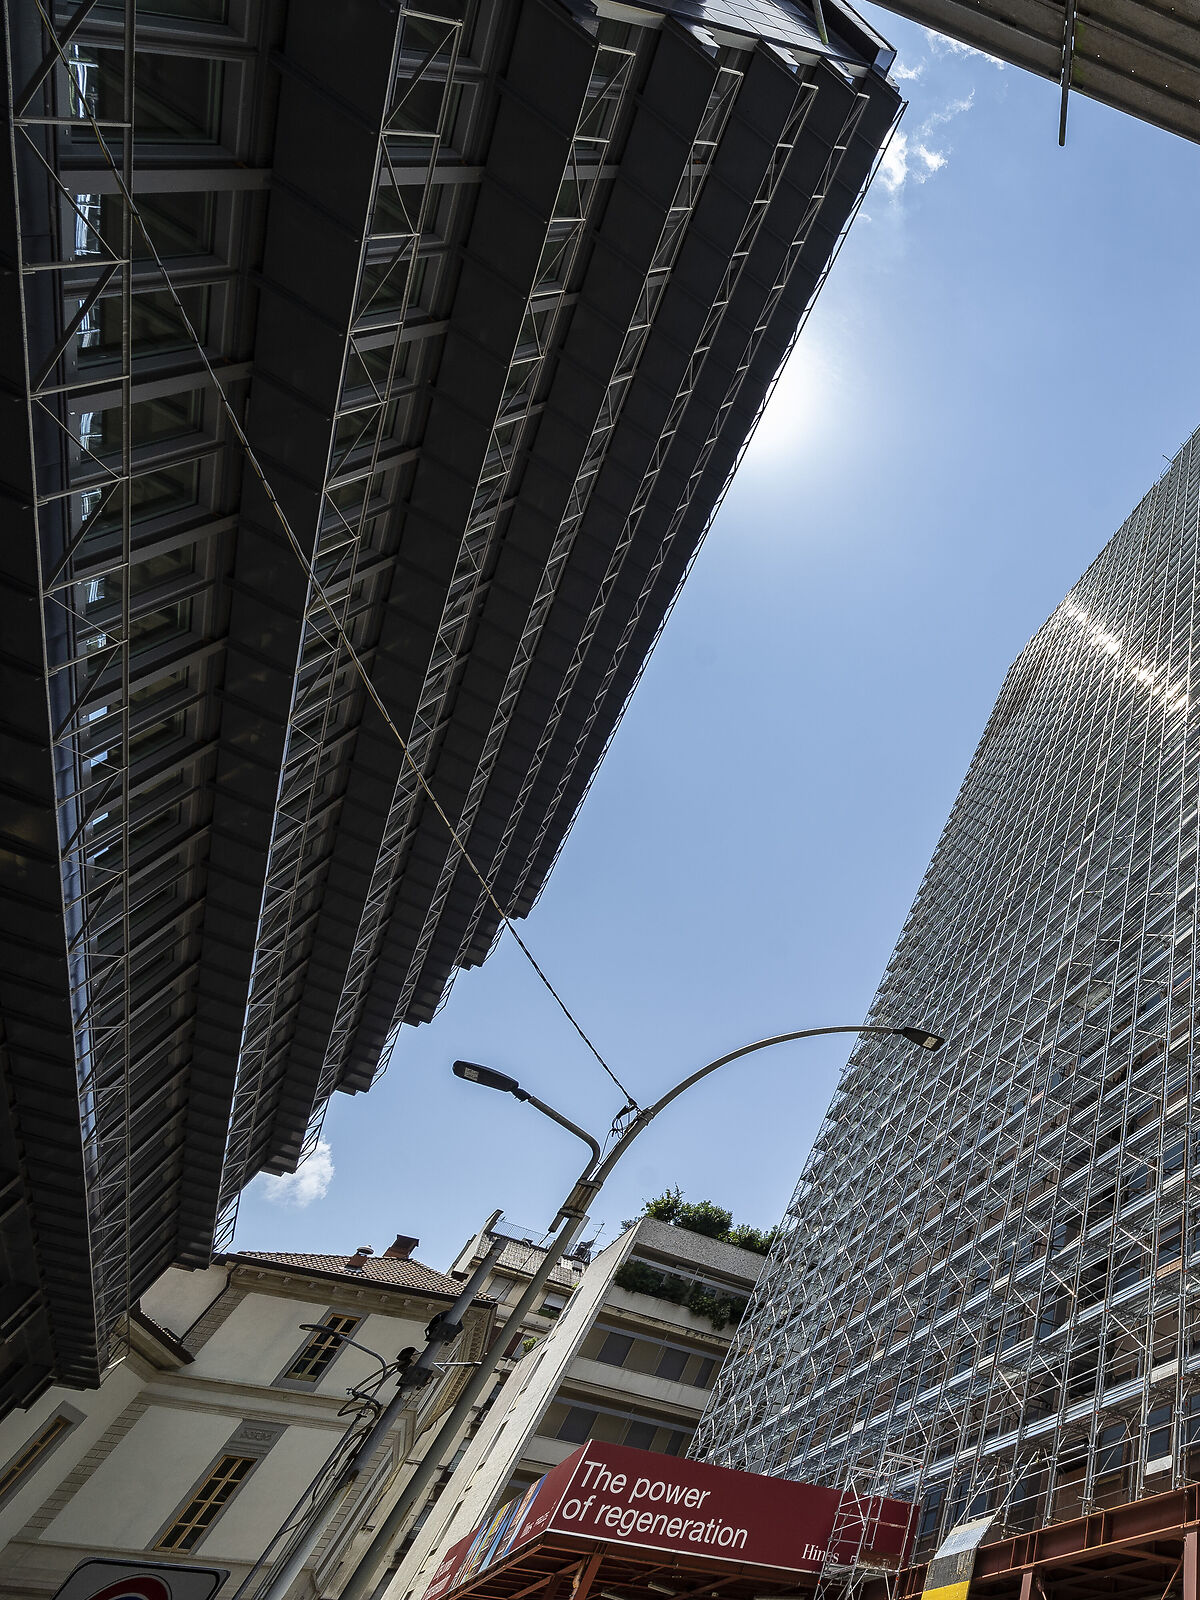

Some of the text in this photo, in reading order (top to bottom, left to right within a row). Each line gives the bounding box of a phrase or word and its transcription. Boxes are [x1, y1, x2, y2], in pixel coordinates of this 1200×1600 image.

[580, 1460, 711, 1510] The power
[562, 1494, 597, 1522] of
[593, 1503, 749, 1549] regeneration
